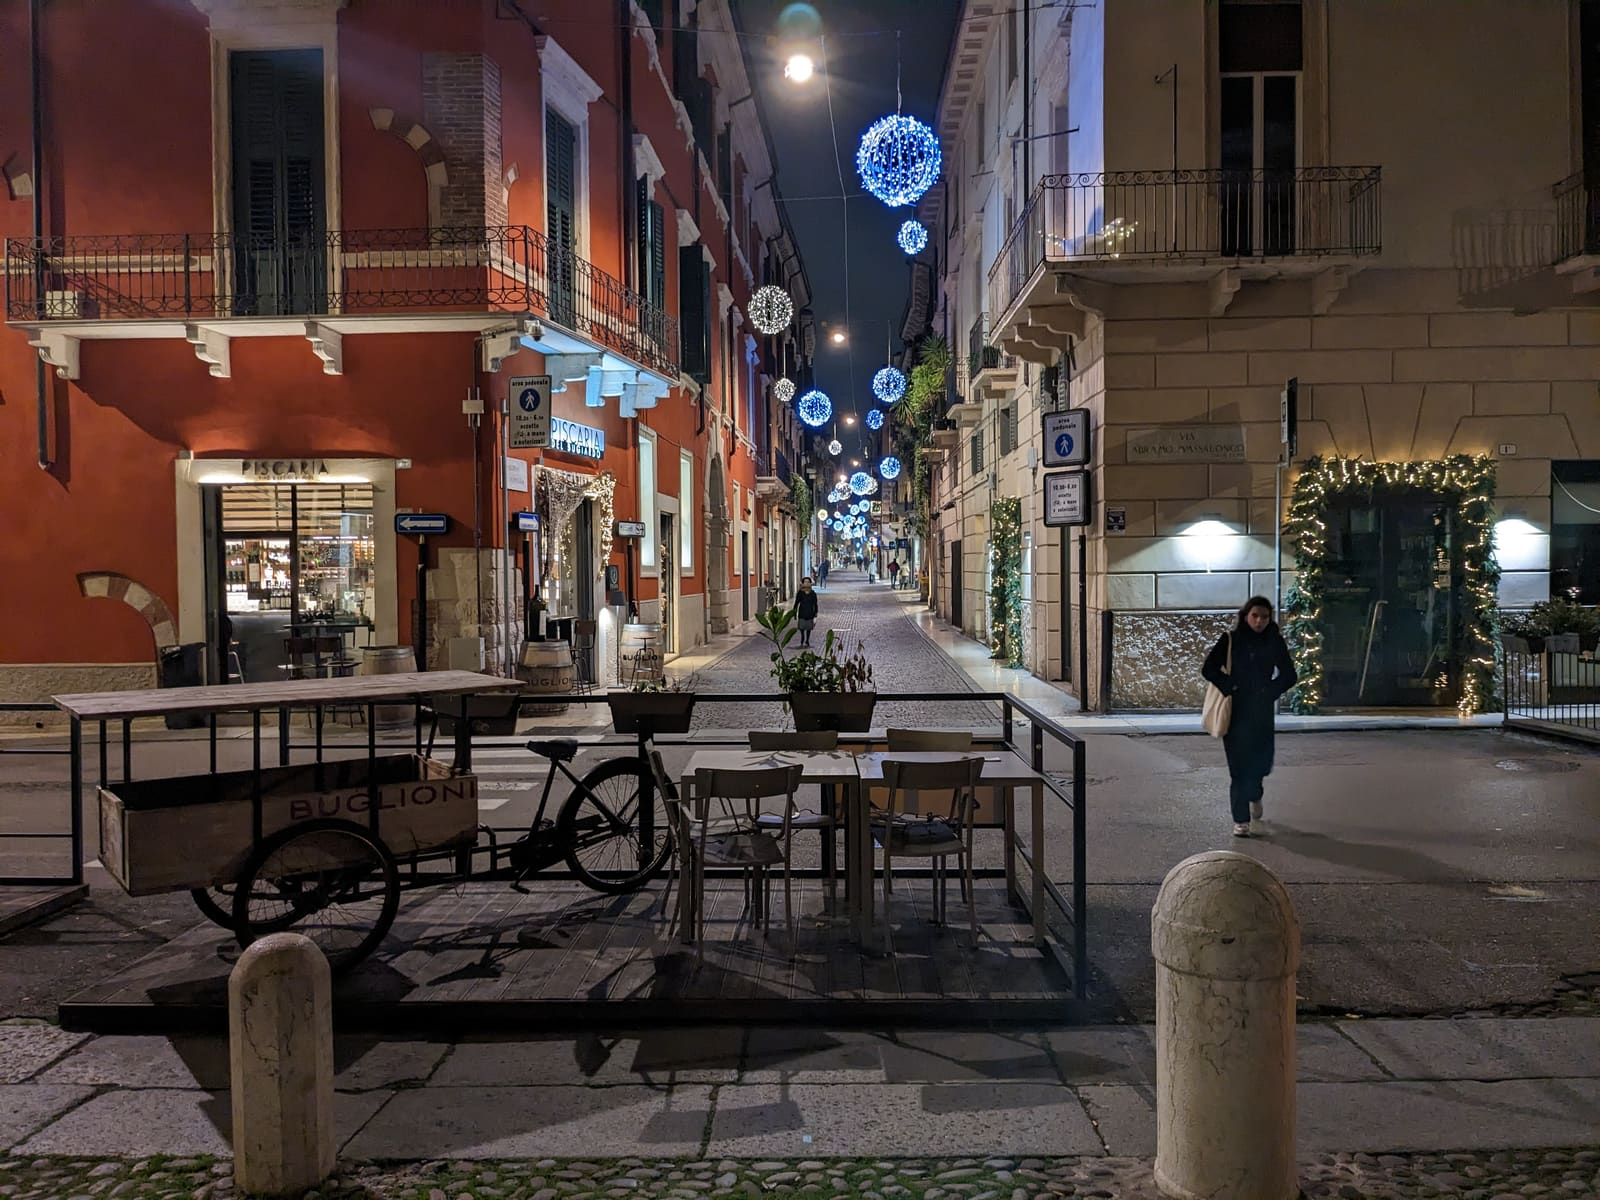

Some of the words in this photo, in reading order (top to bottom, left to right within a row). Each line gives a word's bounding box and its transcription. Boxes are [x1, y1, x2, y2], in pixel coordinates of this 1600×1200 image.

[551, 418, 600, 448] PISCARIA
[1052, 423, 1076, 432] pedonale
[1179, 431, 1196, 441] VIA
[551, 438, 564, 450] DEL
[566, 442, 601, 459] BUGIARDO
[242, 461, 328, 475] PISCARIA
[290, 780, 475, 820] BUGLIONI
